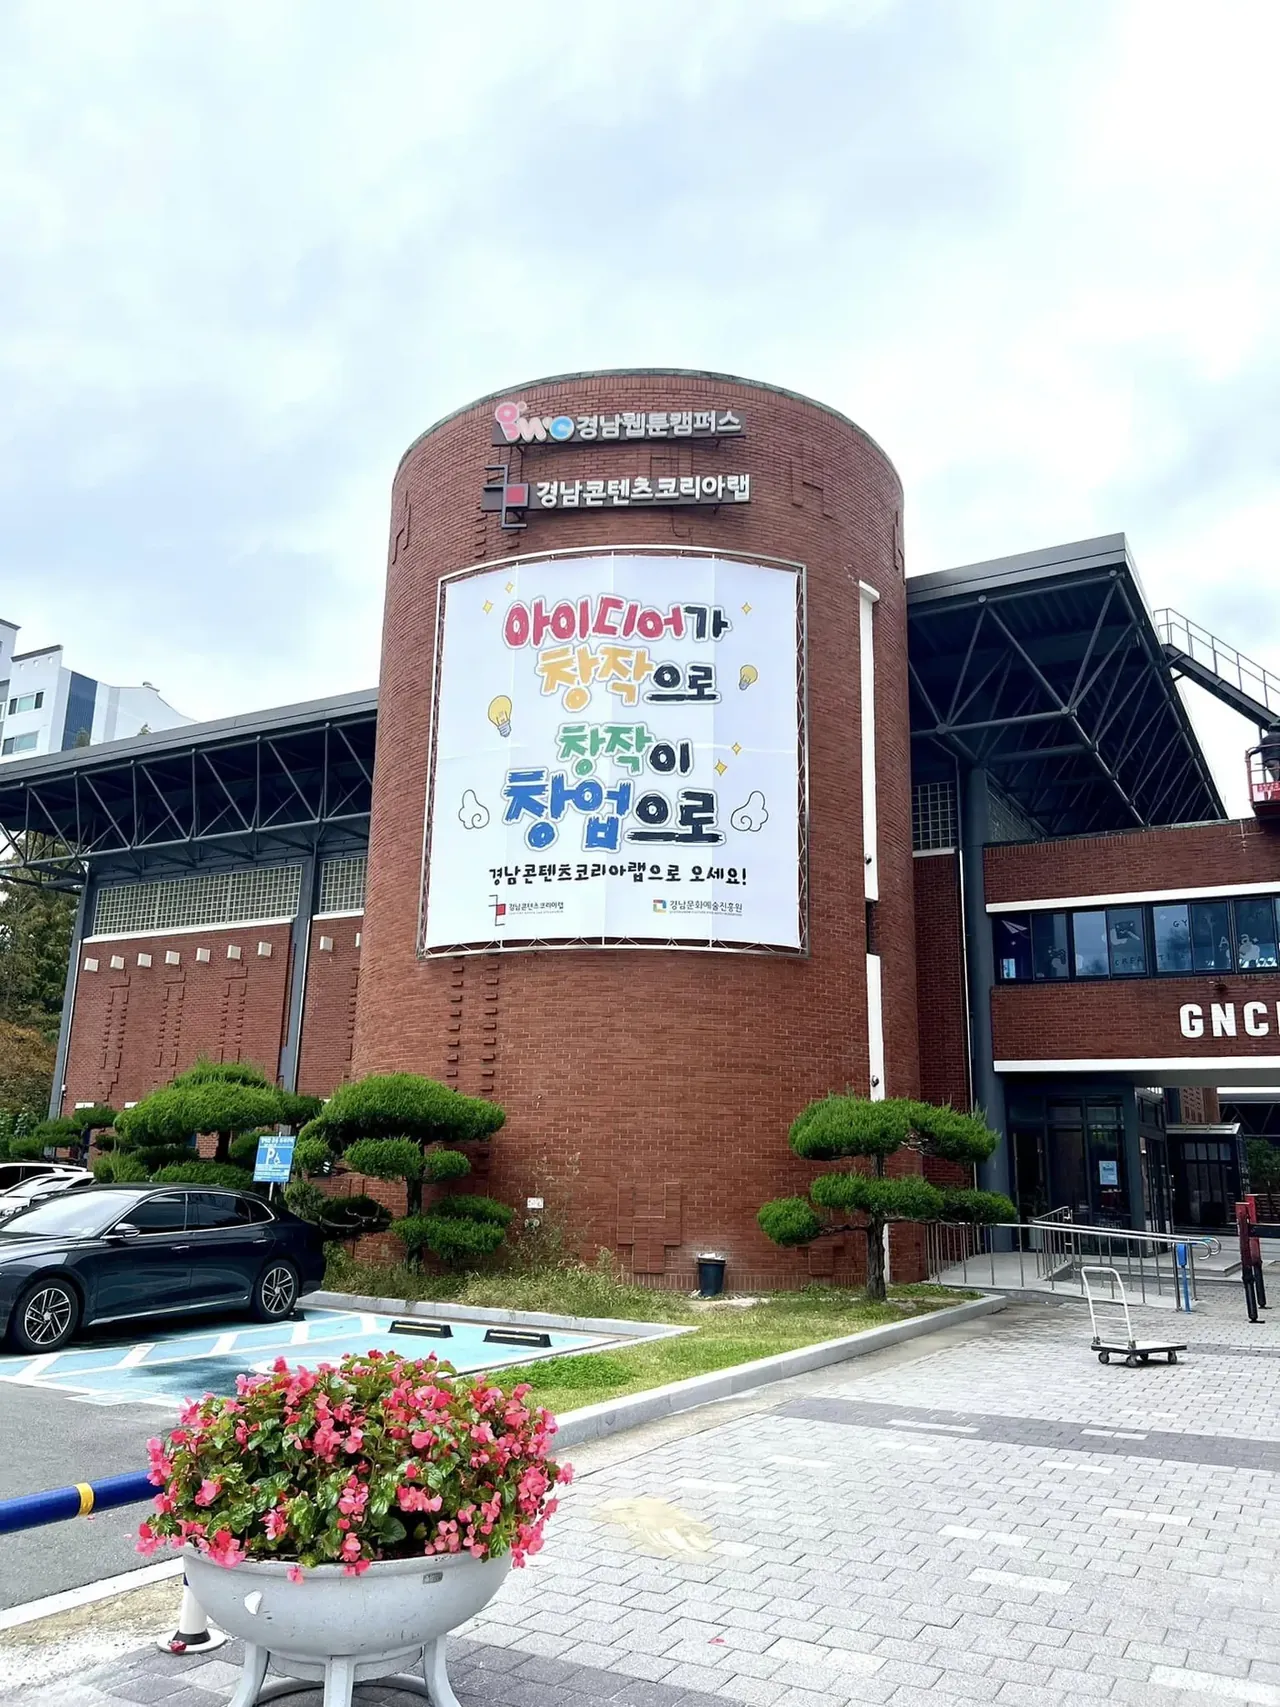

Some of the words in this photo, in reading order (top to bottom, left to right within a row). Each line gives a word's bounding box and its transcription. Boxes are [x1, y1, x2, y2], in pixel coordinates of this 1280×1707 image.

[575, 409, 742, 440] 경남웹툰캠퍼스
[505, 597, 730, 647] 아이디어가
[539, 647, 719, 709] 창작으로
[559, 725, 691, 774] 창작이
[503, 769, 724, 850] 창업으로
[489, 861, 682, 886] 경남콘텐츠코리아랩으로
[689, 865, 748, 886] 오세요!
[669, 899, 743, 913] 경남문화예술진흥원
[1179, 1001, 1280, 1038] GNC
